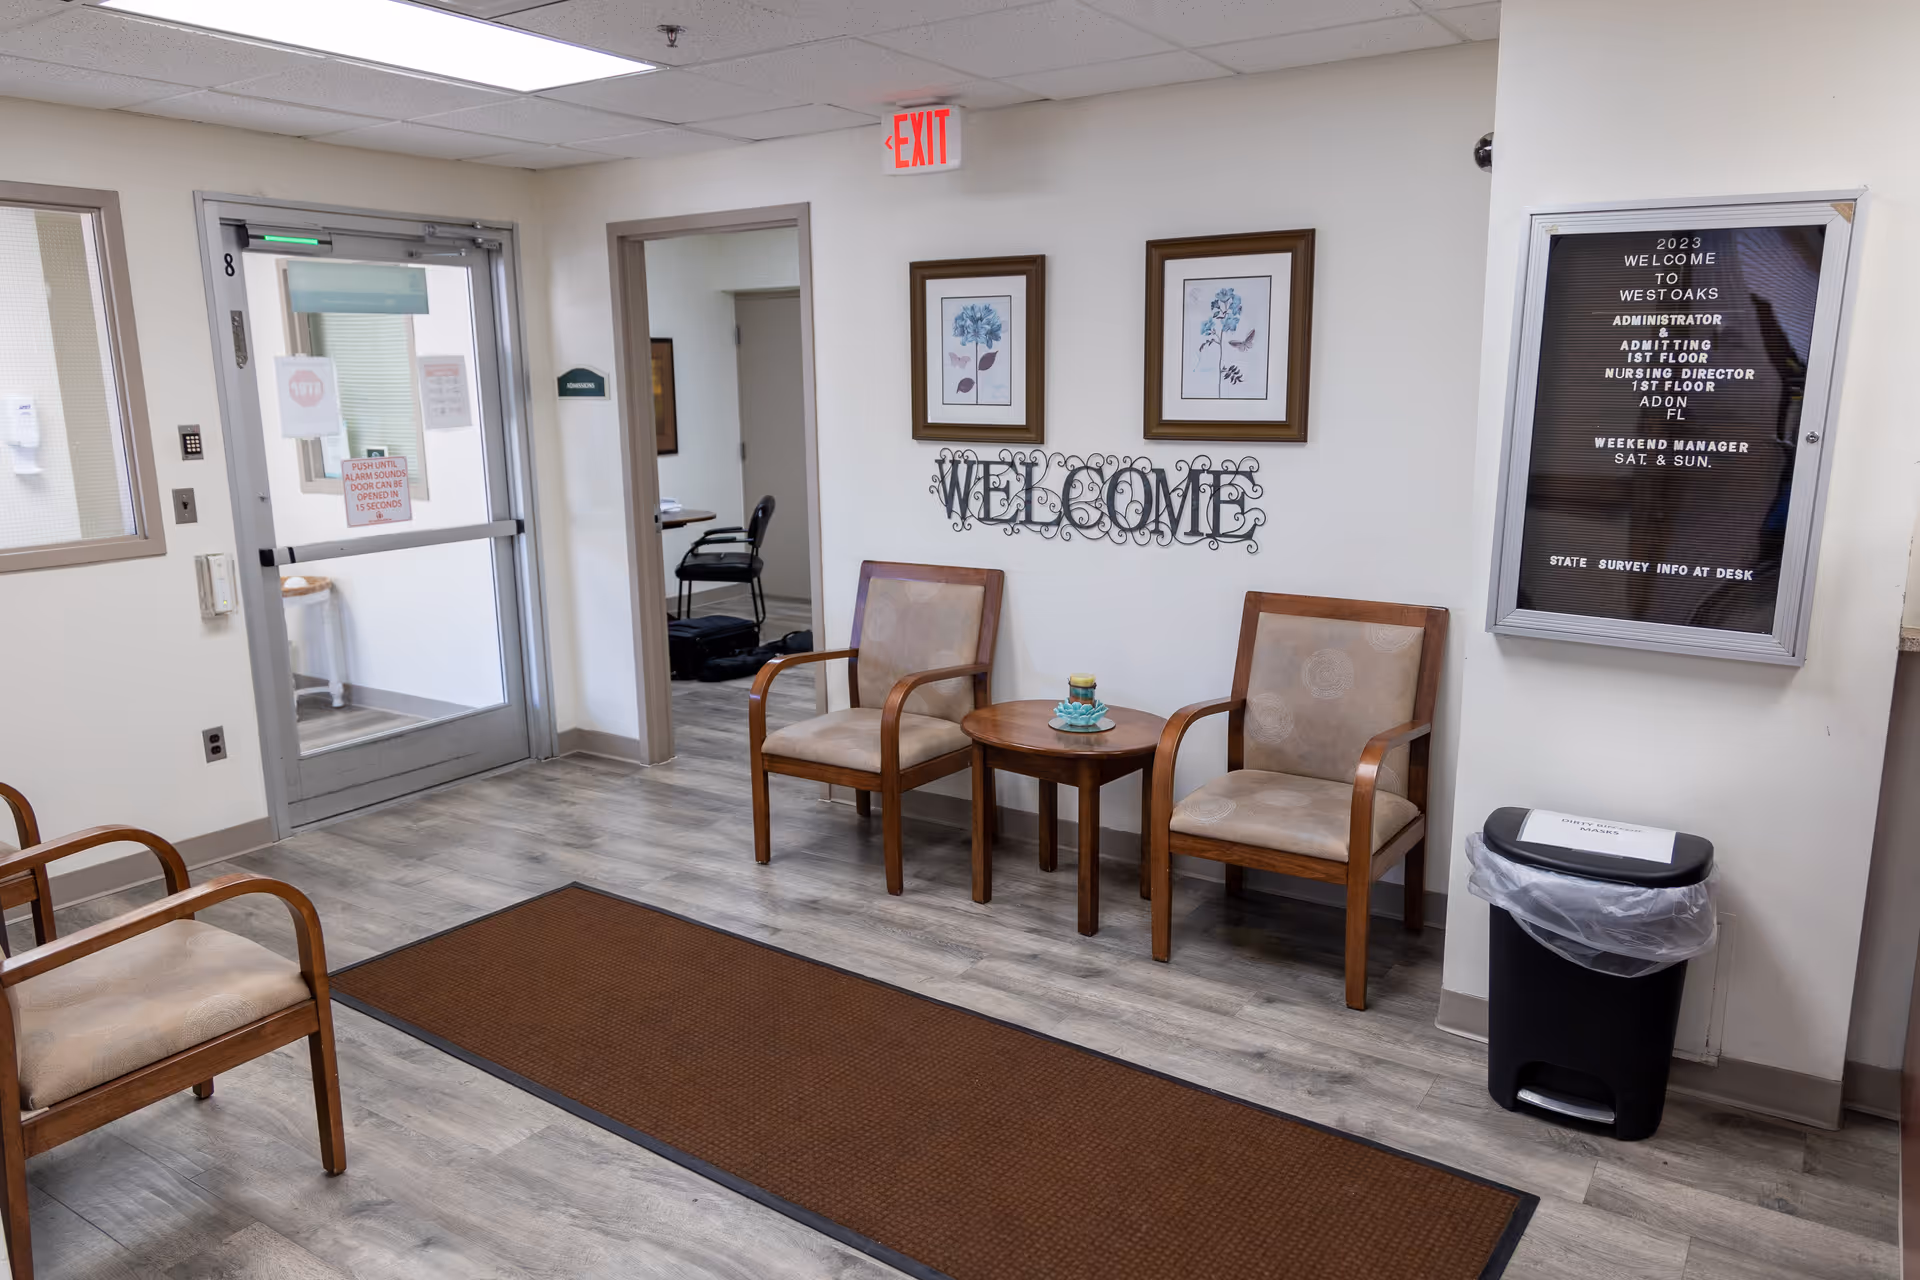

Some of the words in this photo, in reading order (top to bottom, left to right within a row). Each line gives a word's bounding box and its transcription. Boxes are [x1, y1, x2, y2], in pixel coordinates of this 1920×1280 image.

[893, 108, 950, 168] EXIT
[1656, 236, 1701, 250] 2023
[224, 252, 235, 277] 8
[1624, 252, 1716, 267] WELCOME
[1655, 272, 1678, 285] TO
[1619, 288, 1667, 301] WEST
[1670, 287, 1719, 300] OAKS
[1612, 314, 1722, 326] ADMINISTRATOR
[1658, 327, 1669, 338] &
[1620, 339, 1712, 351] ADMITTING
[1659, 352, 1708, 363] FLOOR
[1604, 367, 1673, 379] NURSING
[1681, 368, 1755, 379] DIRECTOR
[1631, 380, 1659, 391] 1ST
[1664, 380, 1715, 392] FLOOR
[1666, 408, 1686, 420] FL
[1594, 437, 1668, 449] WEEKEND
[1673, 439, 1749, 453] MANAGER
[351, 462, 374, 471] PUSH
[375, 460, 398, 470] UNTIL
[1614, 452, 1648, 466] SAT.
[1656, 454, 1666, 466] &
[1673, 455, 1712, 468] SUN.
[345, 472, 374, 482] ALARM
[374, 469, 406, 480] SOUNDS
[351, 482, 374, 492] DOOR
[375, 481, 392, 490] CAN
[393, 479, 403, 488] BE
[357, 491, 389, 502] OPENED
[390, 490, 399, 498] IN
[932, 452, 1260, 546] WELCOME
[356, 503, 365, 511] 15
[366, 499, 403, 511] SECONDS
[1549, 555, 1588, 568] STATE
[1598, 559, 1650, 573] SURVEY
[1656, 563, 1689, 576] INFO
[1693, 566, 1710, 577] AT
[1716, 568, 1754, 581] DESK
[1579, 826, 1620, 836] MASKS
